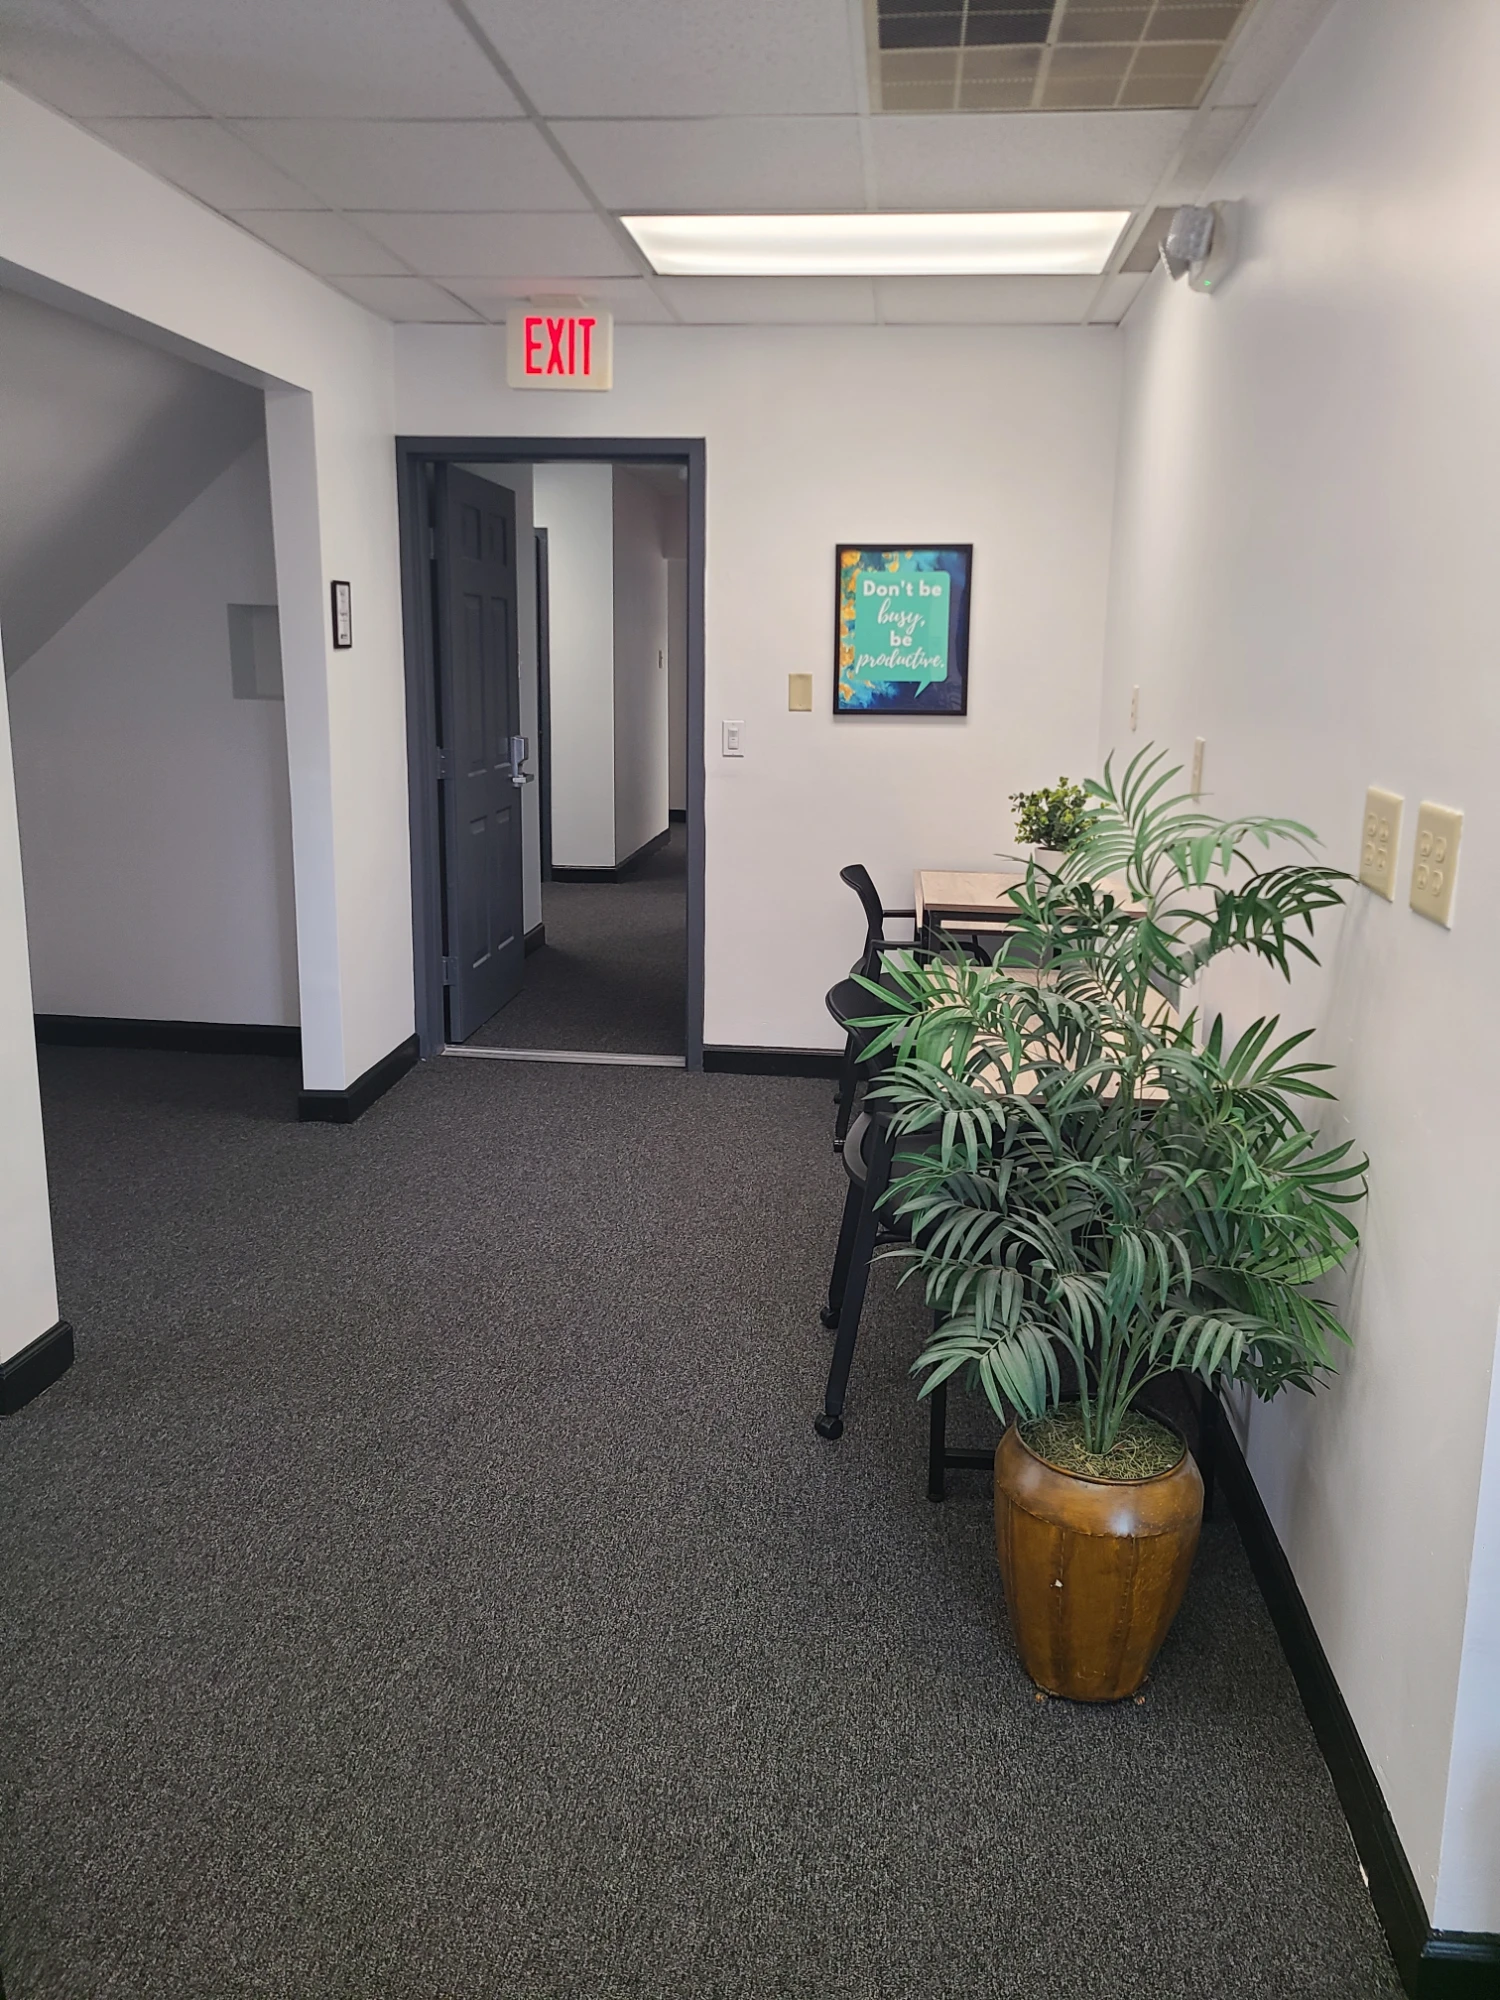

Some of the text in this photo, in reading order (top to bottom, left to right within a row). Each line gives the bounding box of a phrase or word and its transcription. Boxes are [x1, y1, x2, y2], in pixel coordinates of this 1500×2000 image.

[526, 318, 596, 375] EXIT
[863, 580, 942, 597] Don't be
[877, 597, 925, 635] busy,
[889, 630, 912, 647] be
[855, 647, 945, 675] productive.
